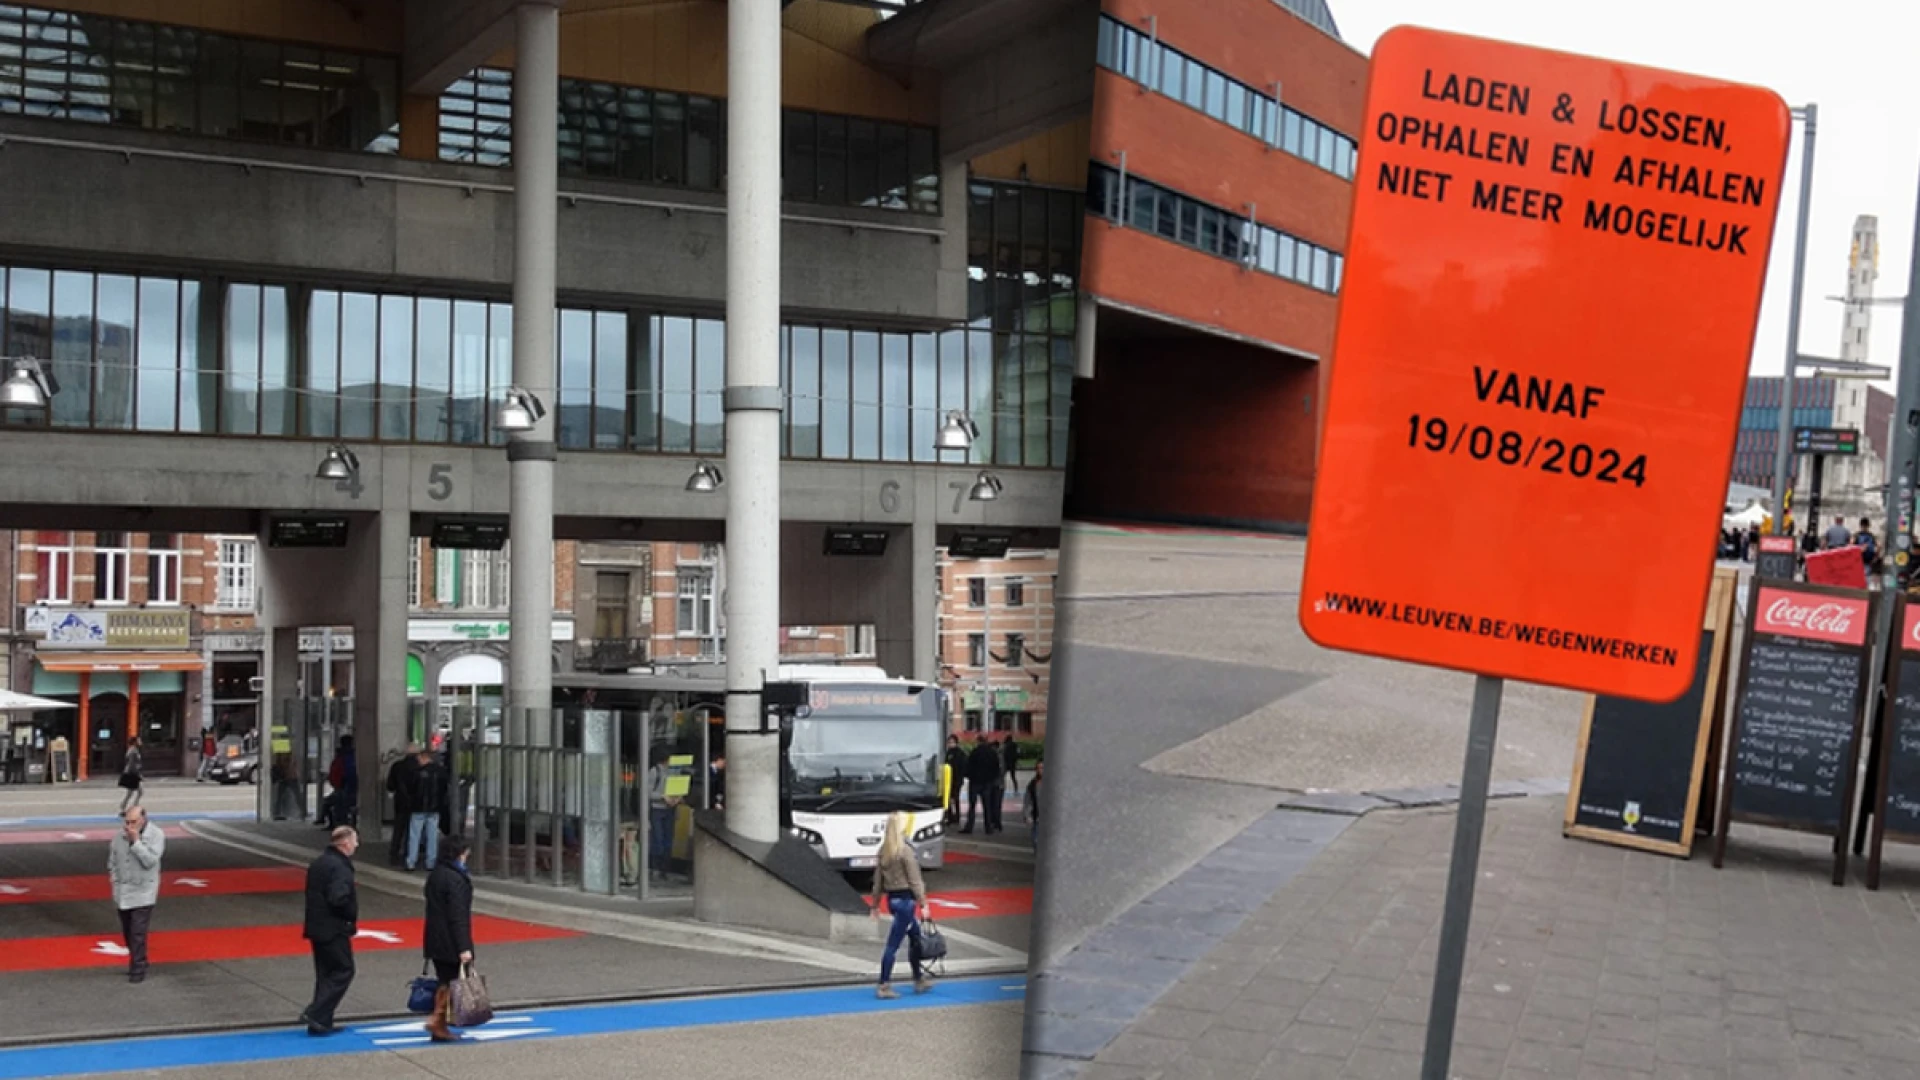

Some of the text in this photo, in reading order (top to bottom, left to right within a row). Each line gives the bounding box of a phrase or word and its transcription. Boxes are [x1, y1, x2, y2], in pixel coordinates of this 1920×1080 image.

[1422, 69, 1732, 155] LADEN & LOSSEN,
[1377, 112, 1764, 207] OPHALEN EN AFHALEN
[1377, 162, 1749, 255] NIET MEER MOGELIJK
[1473, 366, 1605, 419] VANAF
[1408, 414, 1647, 488] 19/08/2024
[427, 463, 453, 501] 5
[879, 479, 901, 514] 6
[948, 481, 970, 515] 7
[109, 626, 185, 636] RESTAURANT
[110, 615, 185, 626] HIMALAYA
[1325, 592, 1678, 667] WWW.LEUVEN.BE/WEGENWERKEN
